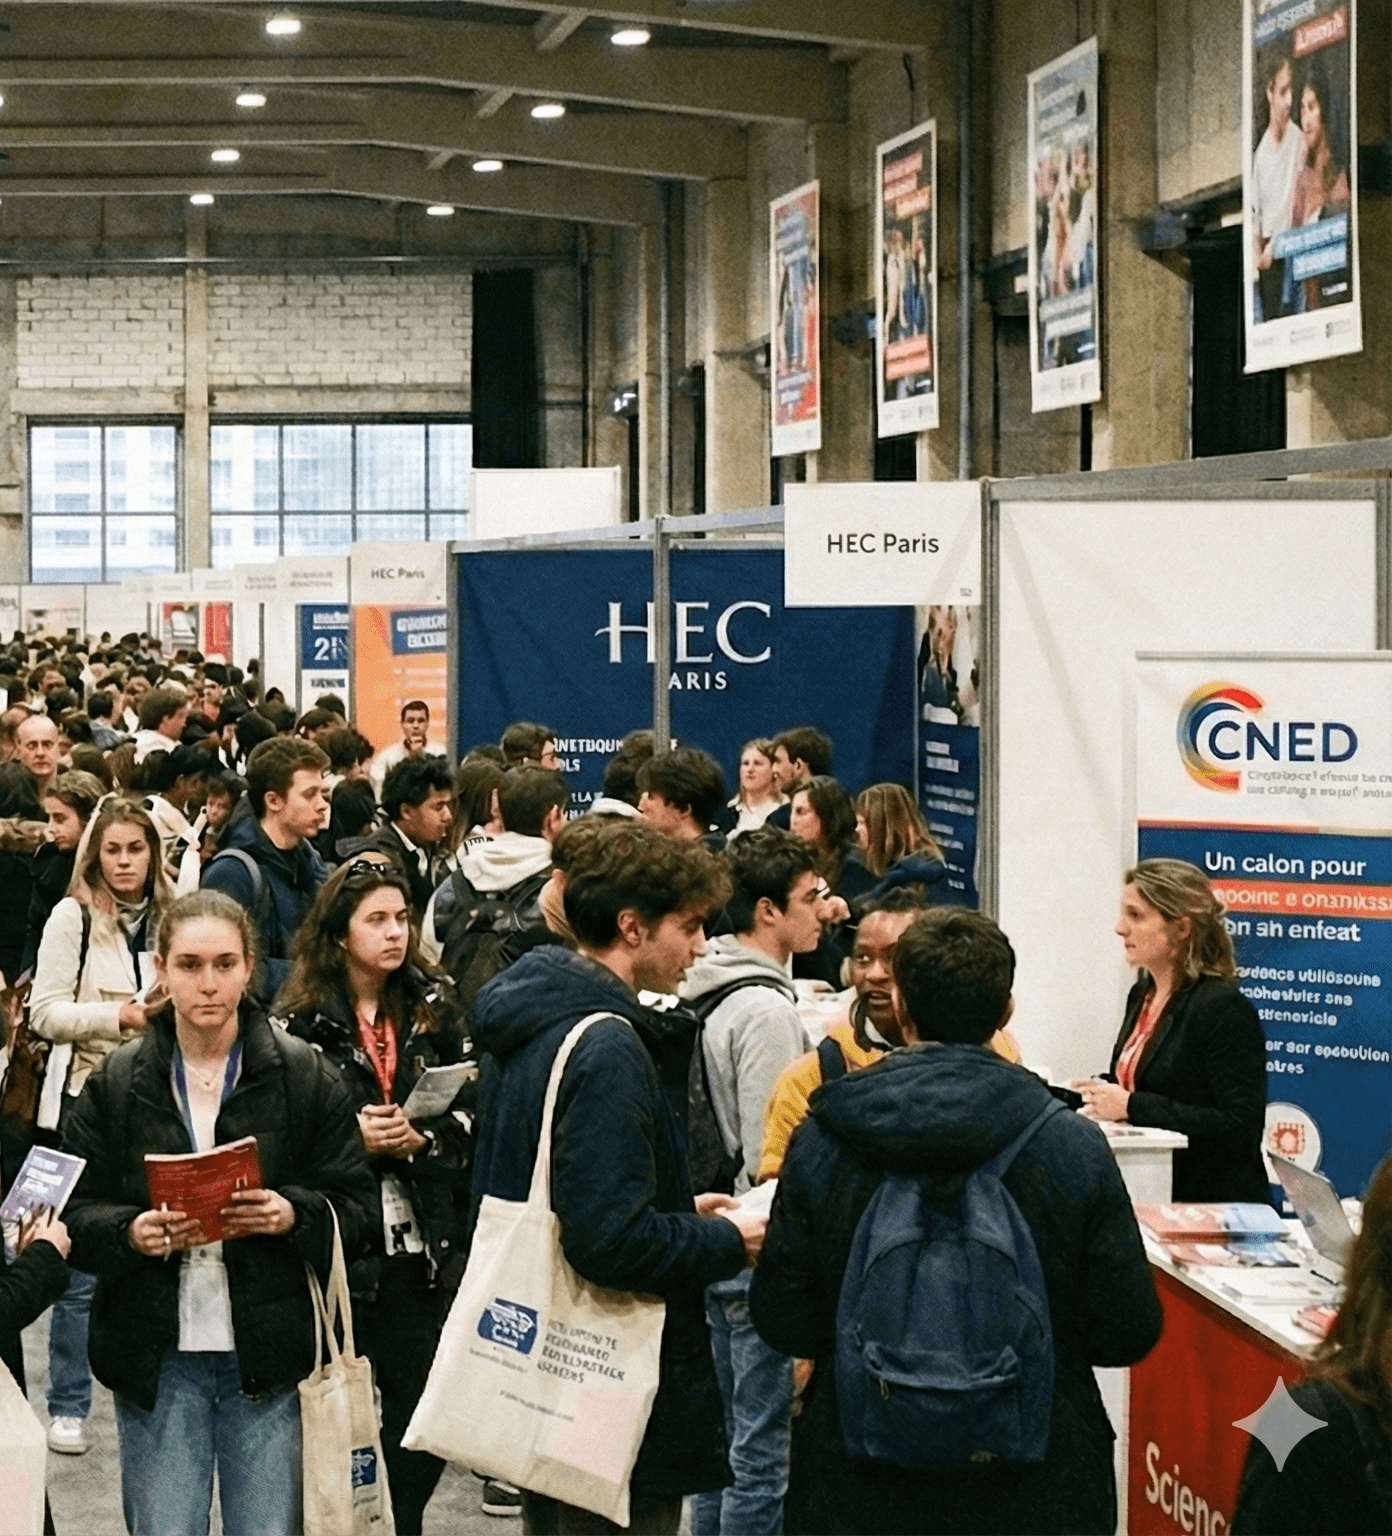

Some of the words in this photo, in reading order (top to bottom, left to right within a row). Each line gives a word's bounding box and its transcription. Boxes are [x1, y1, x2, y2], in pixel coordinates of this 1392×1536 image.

[827, 533, 877, 554] HEC
[884, 533, 940, 554] Paris
[594, 600, 771, 664] HEC
[667, 671, 728, 690] ARIS
[1208, 720, 1358, 763] CNED
[1205, 851, 1236, 871] Un
[1242, 853, 1305, 874] calon
[1311, 859, 1367, 880] pour
[1145, 1441, 1232, 1536] Scienc
